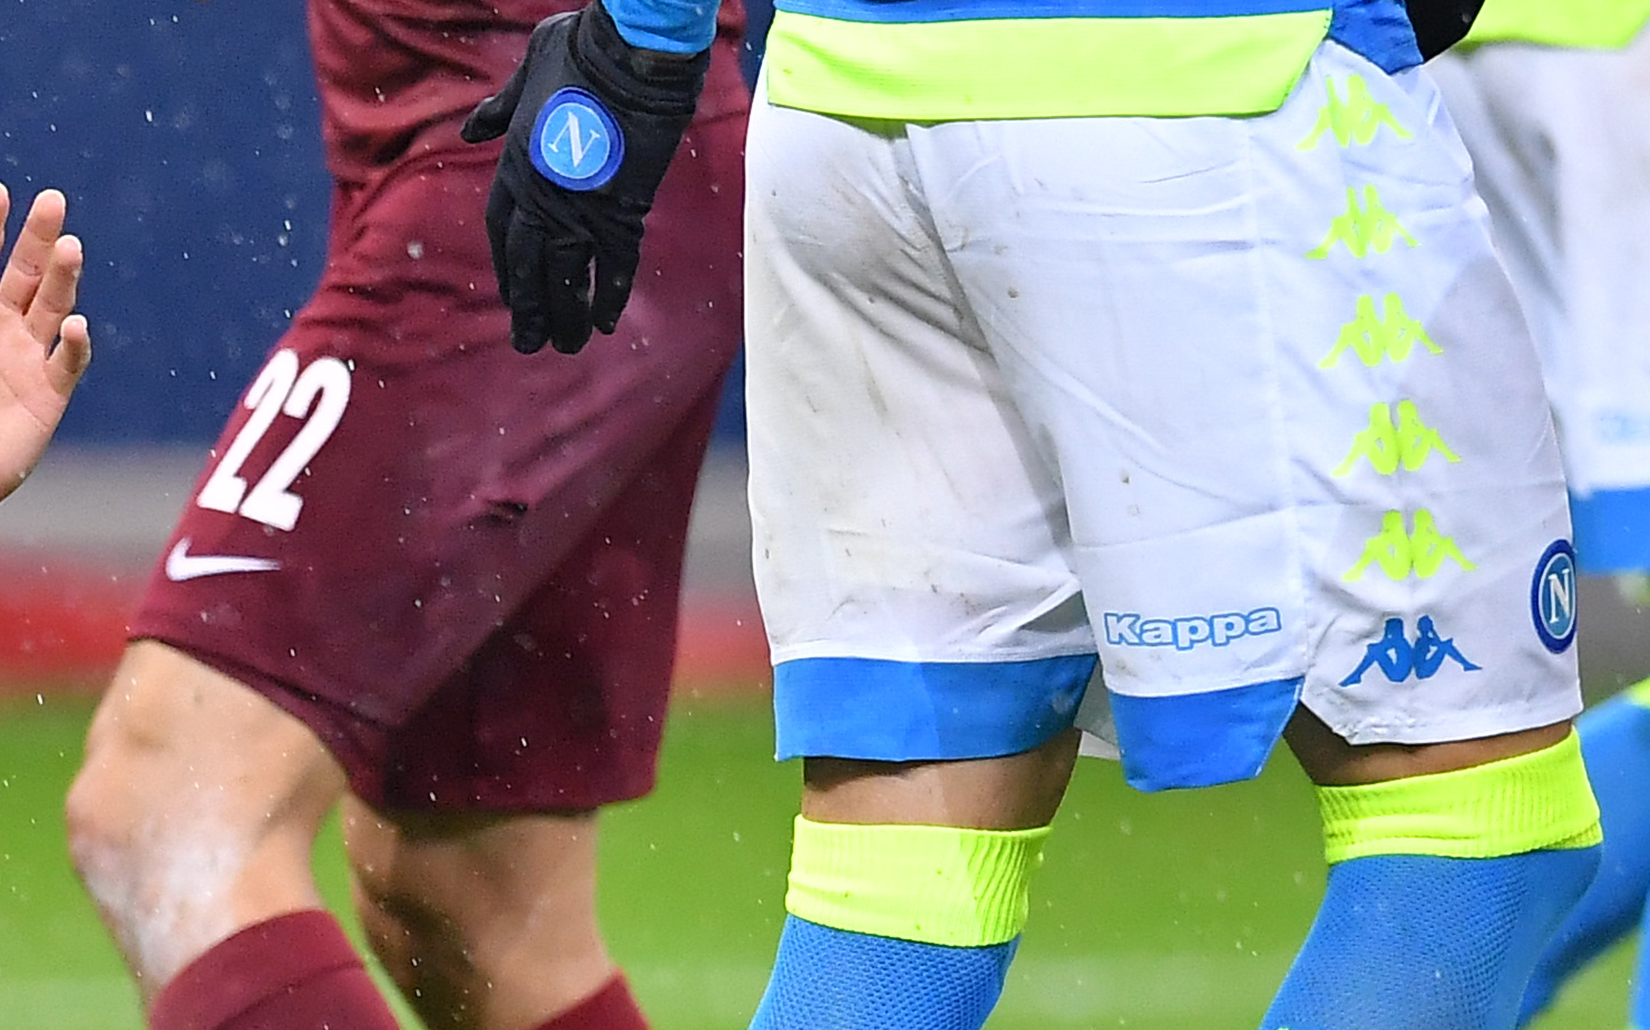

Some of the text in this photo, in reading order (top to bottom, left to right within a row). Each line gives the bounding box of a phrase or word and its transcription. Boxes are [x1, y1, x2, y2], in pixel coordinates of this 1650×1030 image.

[547, 110, 601, 169] N
[196, 348, 352, 533] 22
[1548, 567, 1571, 625] N
[1103, 606, 1282, 651] Kappa
